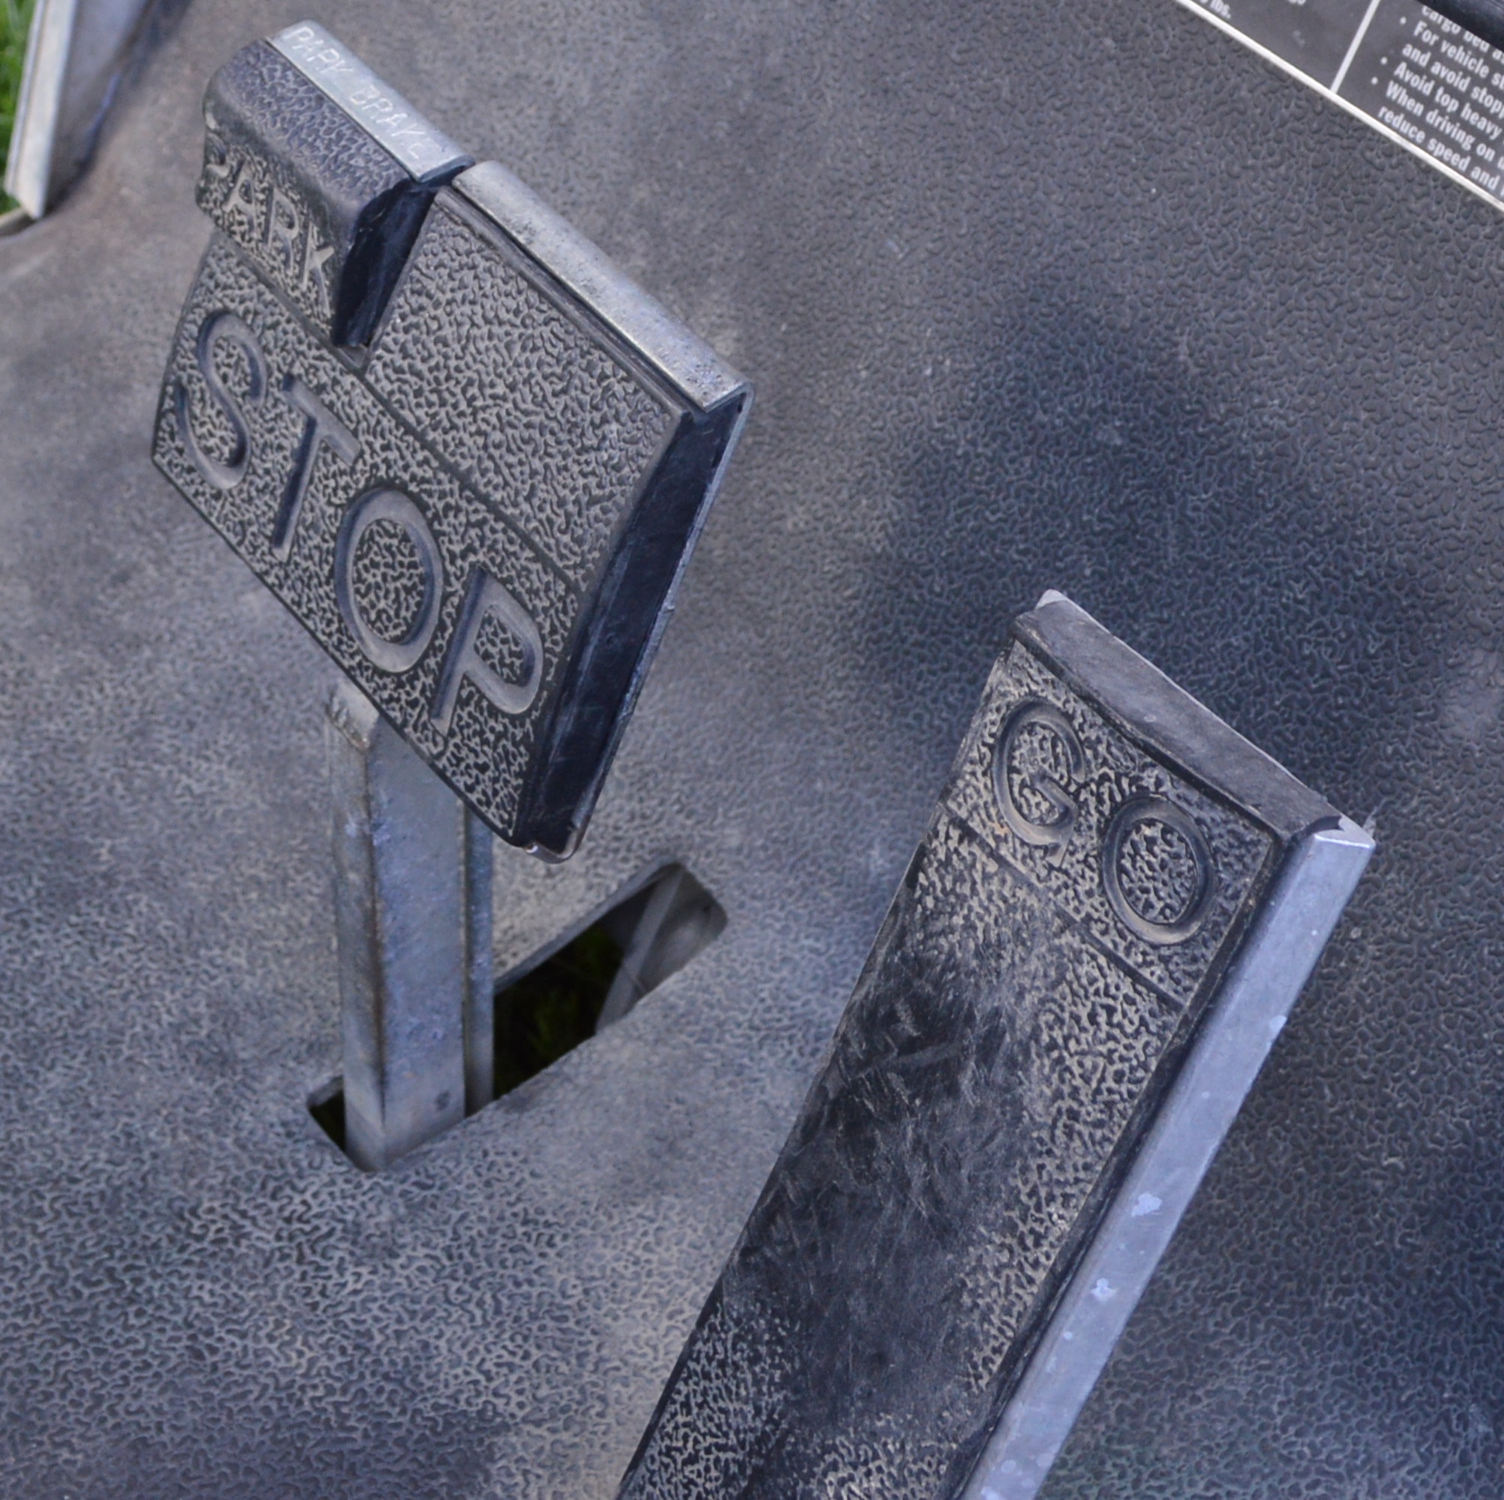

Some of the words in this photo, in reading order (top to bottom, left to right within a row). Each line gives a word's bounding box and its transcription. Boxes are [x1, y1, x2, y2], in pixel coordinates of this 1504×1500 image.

[1401, 43, 1431, 67] and
[1429, 61, 1471, 92] avoid
[1413, 20, 1439, 45] For
[1440, 39, 1489, 78] vehicle
[1393, 61, 1435, 96] Avoid
[1434, 86, 1459, 112] top
[1460, 102, 1502, 140] heavy
[1377, 106, 1425, 143] reduce
[1427, 137, 1471, 172] speed
[1469, 166, 1500, 190] and
[174, 310, 544, 737] STOP
[993, 700, 1216, 946] GO
